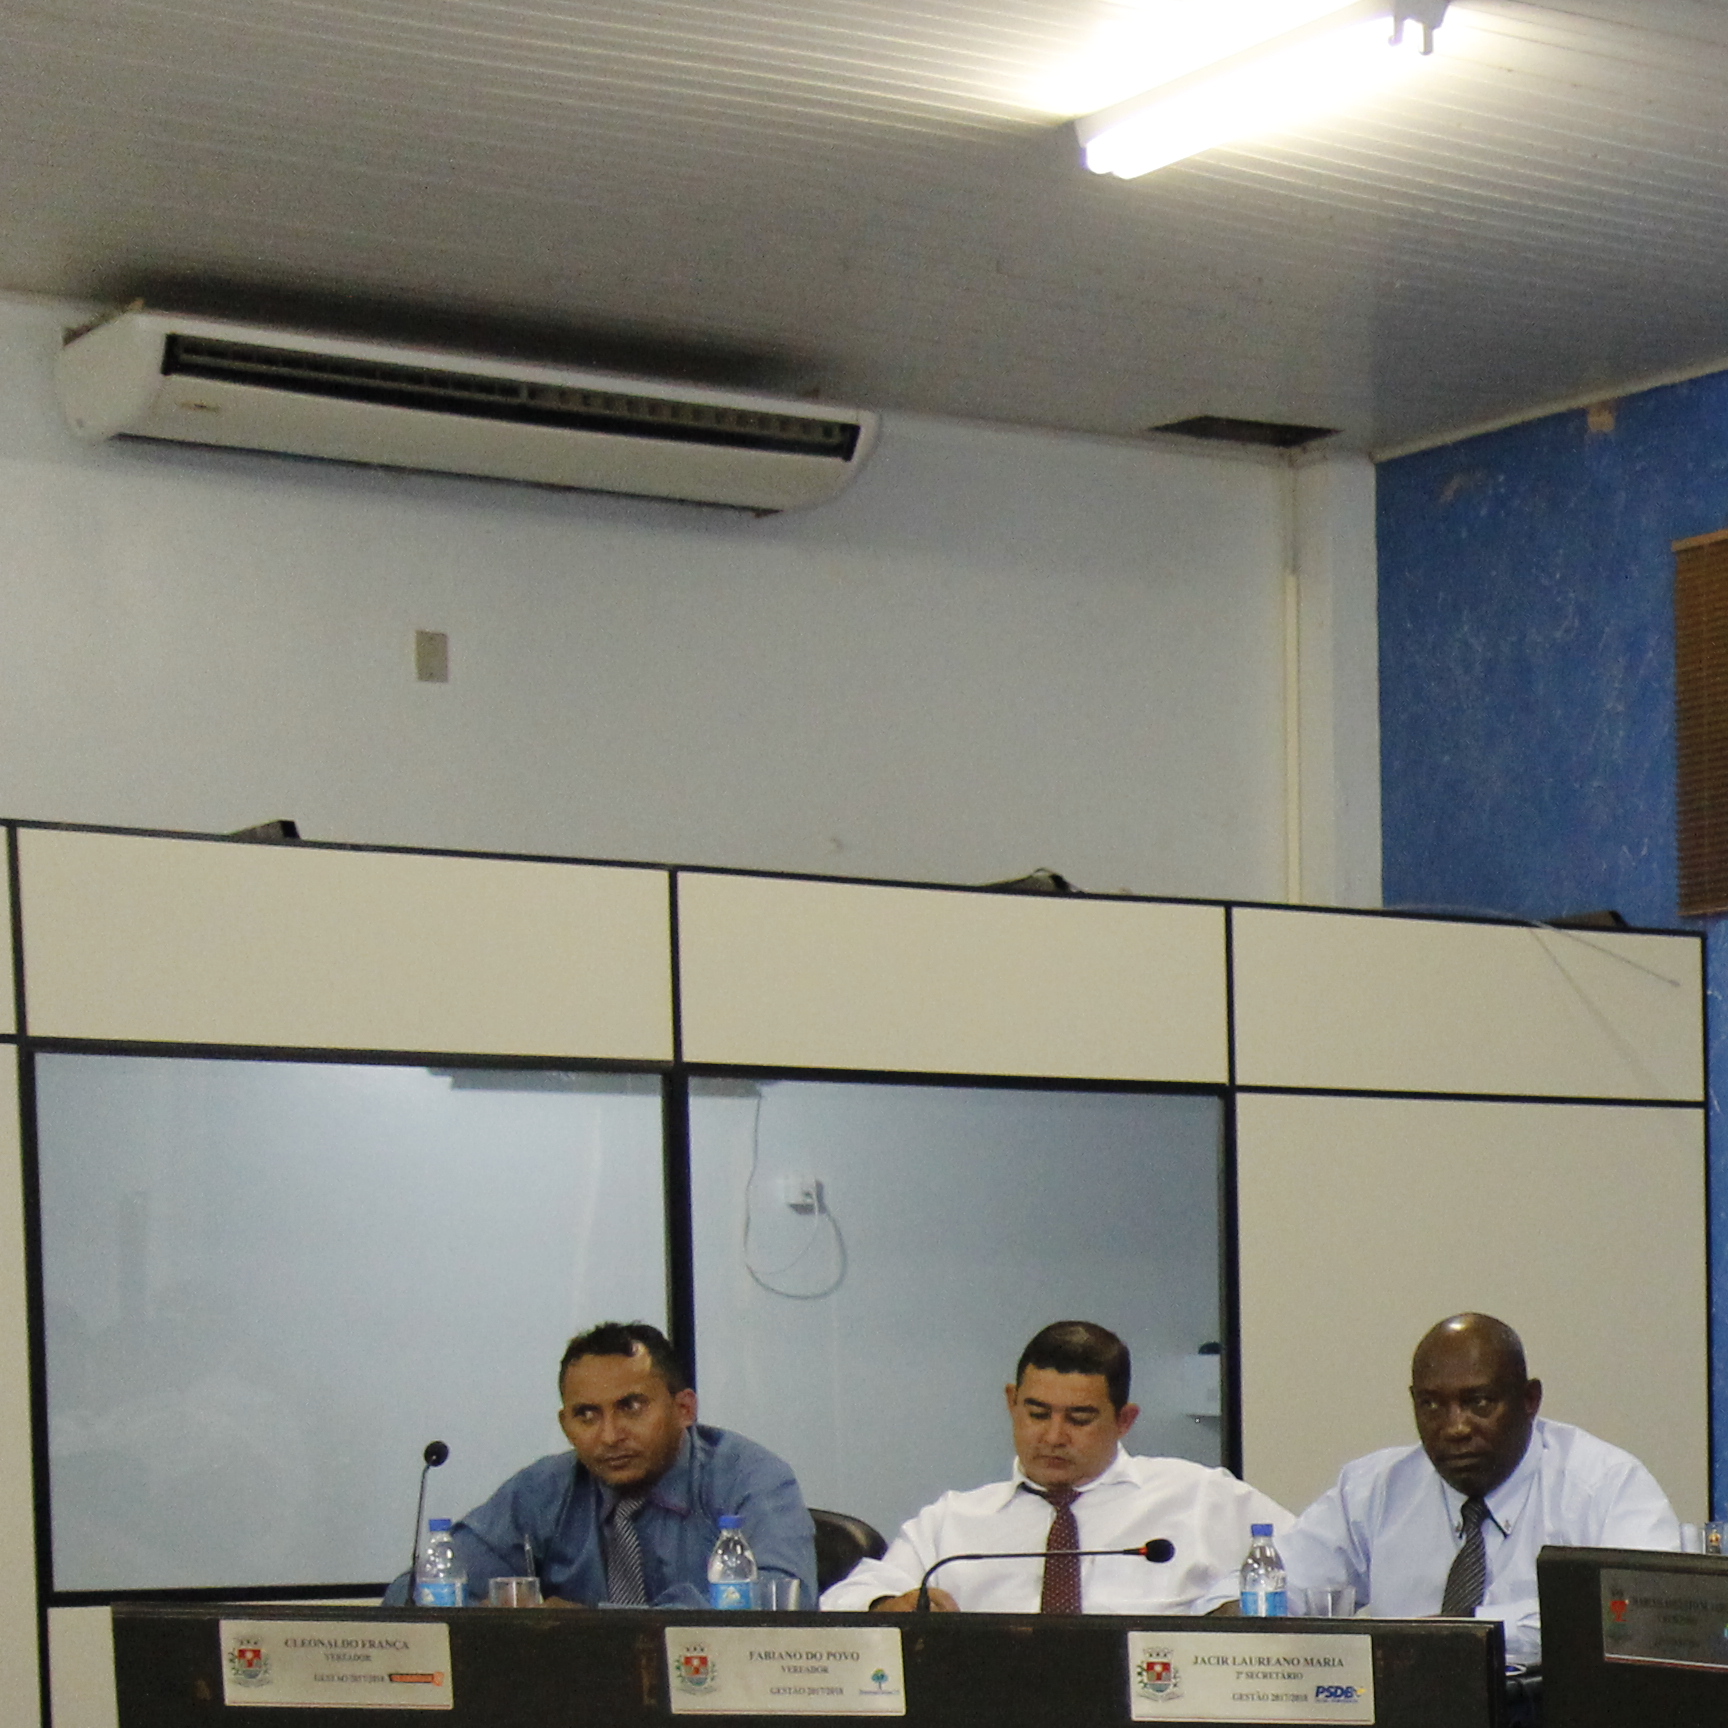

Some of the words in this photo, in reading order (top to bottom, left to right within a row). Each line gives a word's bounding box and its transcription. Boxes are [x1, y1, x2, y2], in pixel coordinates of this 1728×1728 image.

[361, 1639, 410, 1651] FRANÇA
[749, 1650, 803, 1661] FABIANO
[805, 1651, 823, 1662] DO
[826, 1651, 860, 1662] POVO
[1192, 1655, 1230, 1667] JACIR
[1232, 1655, 1300, 1668] LAUREANO
[1302, 1656, 1344, 1668] MARIA
[1314, 1686, 1355, 1699] PSDB
